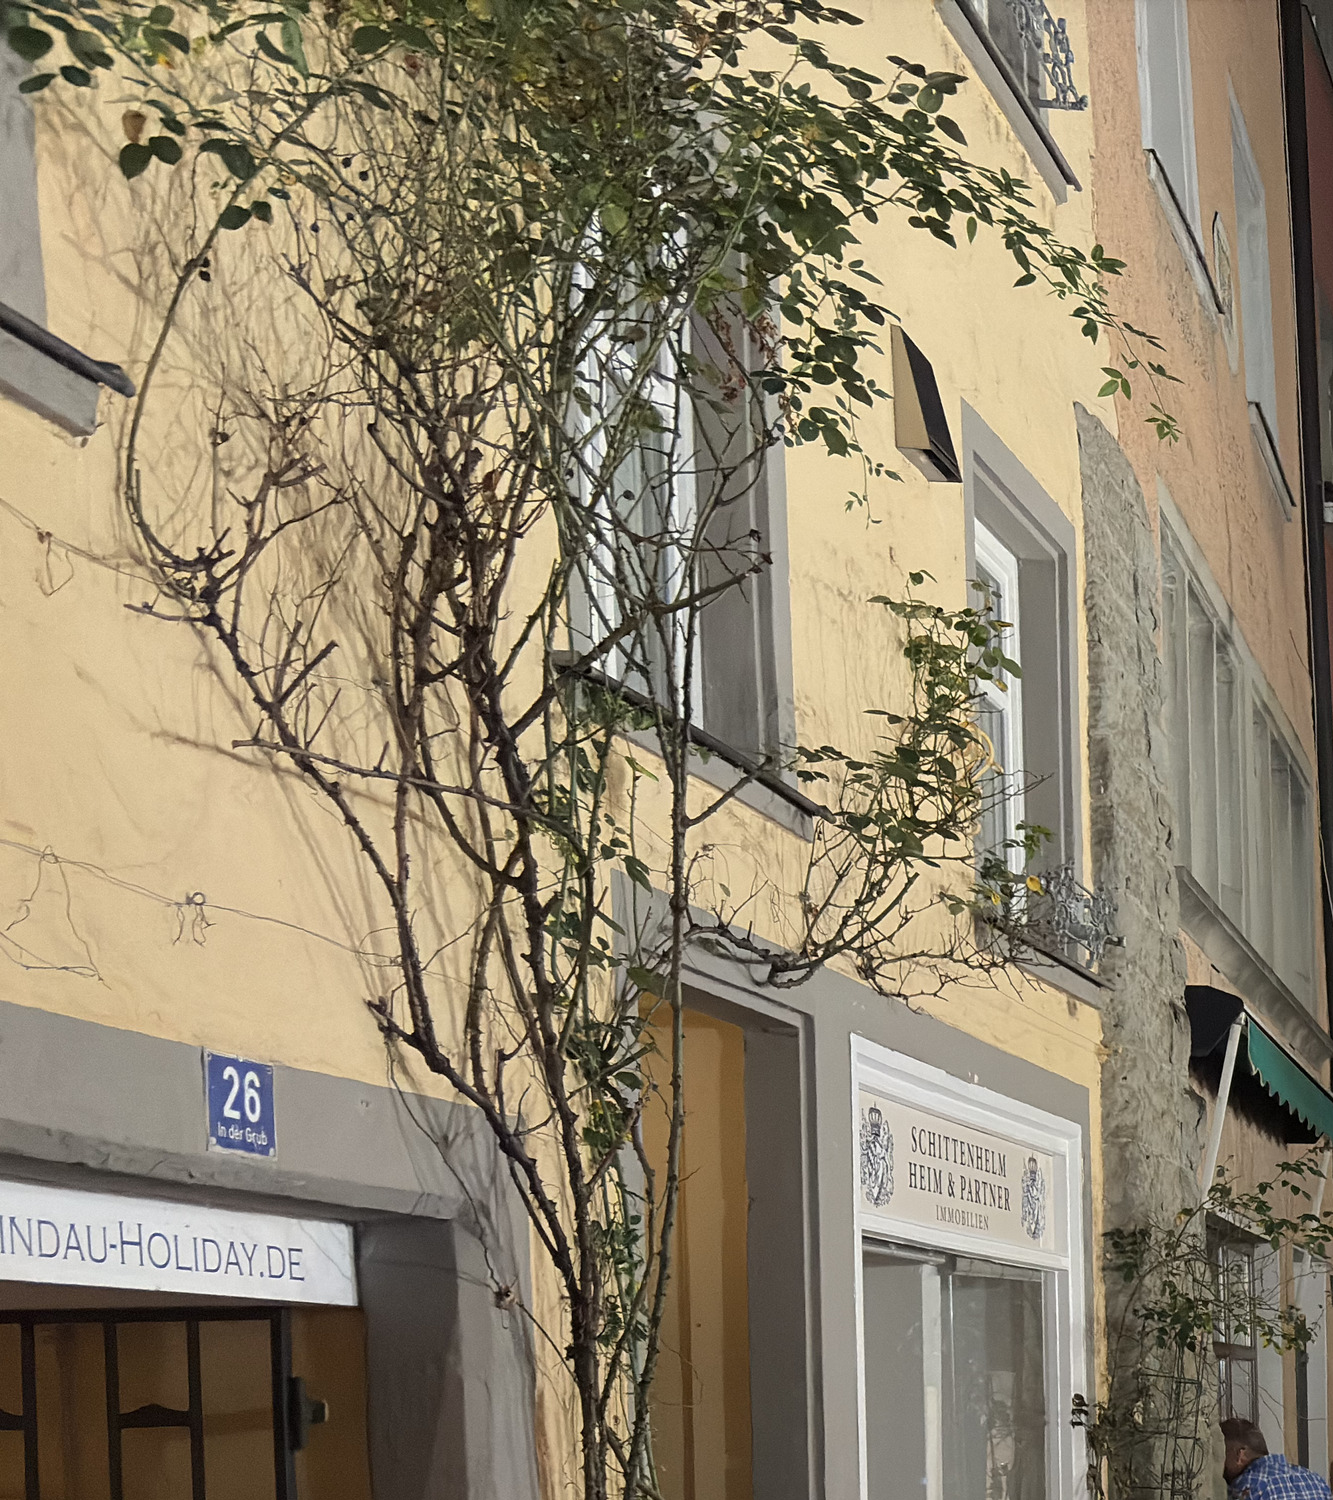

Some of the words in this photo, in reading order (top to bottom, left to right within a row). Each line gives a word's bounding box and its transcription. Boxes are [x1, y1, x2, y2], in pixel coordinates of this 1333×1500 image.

[222, 1065, 261, 1123] 26
[217, 1121, 227, 1138] In
[228, 1124, 243, 1140] der
[245, 1127, 268, 1146] Grub
[911, 1126, 1007, 1178] SCHITTENHELM
[908, 1161, 943, 1195] HEIM
[947, 1172, 956, 1198] &
[959, 1174, 1012, 1212] PARTNER
[936, 1204, 989, 1231] IMMOBILIEN
